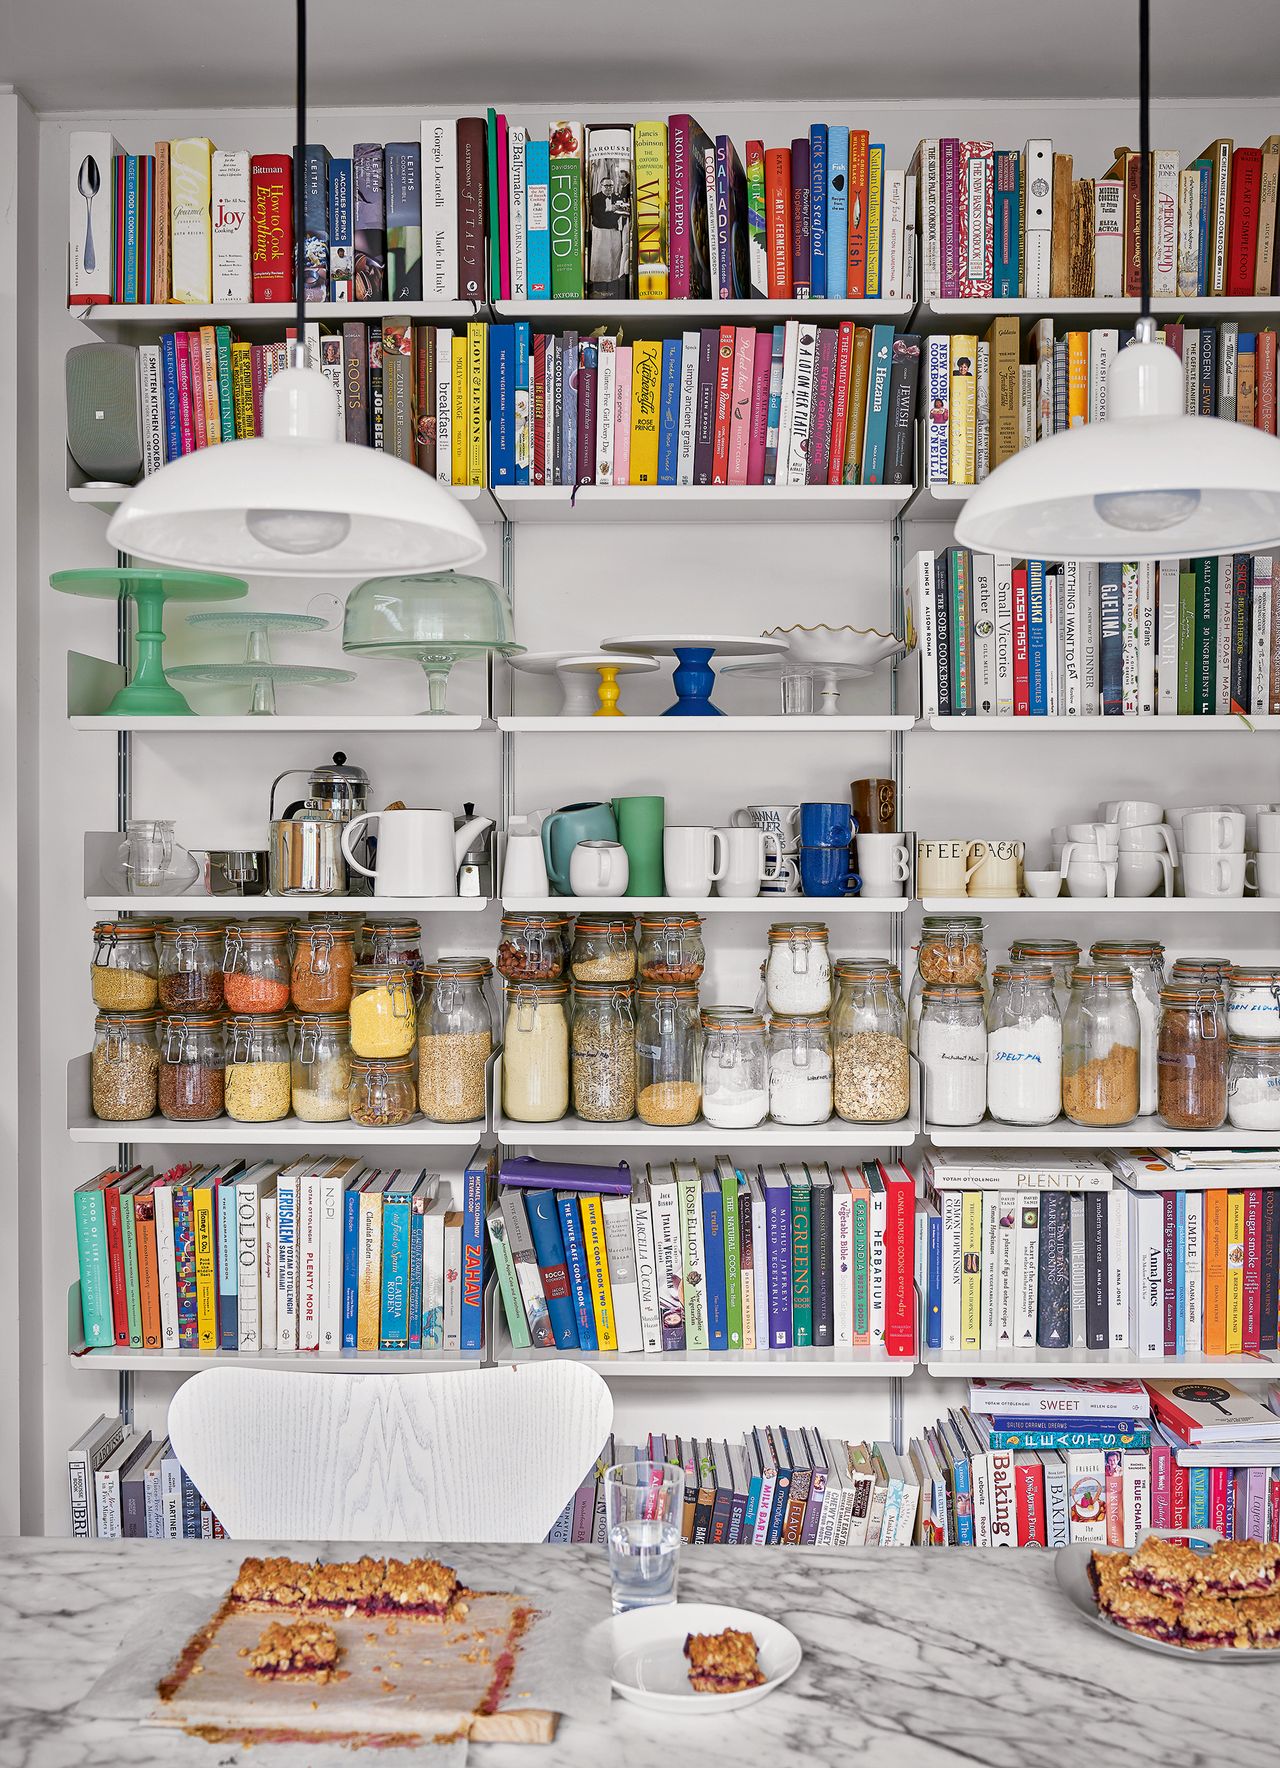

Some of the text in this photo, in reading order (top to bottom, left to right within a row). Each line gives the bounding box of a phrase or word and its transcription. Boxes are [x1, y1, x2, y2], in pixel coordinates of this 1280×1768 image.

[432, 127, 444, 207] Giorgio Locatelli
[513, 146, 523, 206] Ballymaloe
[675, 128, 683, 178] AROMAS
[129, 191, 137, 208] FOOD
[215, 204, 246, 230] Joy
[270, 184, 285, 260] How to Cook
[552, 175, 572, 257] FOOD
[637, 178, 660, 264] WINE
[675, 187, 683, 235] ALEPPO
[718, 148, 728, 244] SALADS
[811, 136, 825, 256] rick stein's seafood
[867, 151, 880, 293] Nathan Outlaw's British Seafood
[927, 148, 937, 241] THE SILVER PALATE COOKBOOK
[973, 162, 982, 259] THE NEW BASICS COOKBOOK
[128, 216, 136, 245] COOKING
[254, 185, 271, 262] Everything
[776, 199, 786, 286] ART FERMENTATION
[433, 231, 445, 295] Made In Italy
[1158, 246, 1174, 274] FOOD
[180, 359, 188, 390] barefoot
[348, 359, 361, 409] ROOTS
[473, 340, 481, 373] LOVE
[635, 348, 659, 415] Kitchenella
[840, 354, 848, 384] FAMILY
[930, 343, 939, 401] COOKBOOK
[939, 343, 948, 401] NEW YORK
[149, 358, 159, 430] SMITTEN KITCHEN
[439, 382, 450, 438] breakfast
[473, 387, 481, 443] LEMONS
[682, 363, 695, 458] simply ancient grains
[717, 367, 729, 419] IVAN Ramen
[793, 348, 812, 438] A LOT ON HER PLATE
[837, 385, 846, 418] DINNER
[873, 367, 887, 413] Hazana
[1262, 371, 1273, 420] PASSOVER
[938, 425, 948, 476] by MOLLY
[977, 576, 991, 613] gather
[1030, 562, 1043, 623] MAMUSHKA
[1101, 584, 1120, 639] GJELINA
[1203, 586, 1211, 619] CLARKE
[998, 582, 1011, 678] Small Victories
[1016, 588, 1027, 660] MISO TASTY
[1066, 618, 1074, 646] WANT
[1143, 607, 1153, 646] 26 Grains
[936, 612, 949, 704] SOBO COOKBOOK
[1066, 649, 1074, 662] TO
[1066, 663, 1078, 681] EAT
[1202, 627, 1210, 697] 30 INGREDIENTS
[325, 1187, 334, 1220] NOPI
[1017, 1174, 1084, 1188] PLENTY
[199, 1211, 208, 1232] Honey
[238, 1190, 257, 1266] POLPO
[278, 1188, 294, 1243] JERUSALEM
[685, 1186, 700, 1266] ROSE ELLIOT'S
[838, 1201, 849, 1260] Vegetable Bible
[1165, 1222, 1175, 1236] figs
[1188, 1214, 1197, 1257] SIMPLE
[1246, 1192, 1258, 1267] salt sugar smoke
[201, 1242, 209, 1251] Co.
[636, 1208, 653, 1303] MARCELLA CUCINA
[794, 1214, 809, 1294] GREENS
[873, 1230, 882, 1309] HERBARIUM
[897, 1246, 905, 1273] COOKS
[1165, 1239, 1173, 1259] sugar
[464, 1245, 480, 1306] ZAHAV
[1147, 1247, 1162, 1306] Anna Jones
[306, 1294, 314, 1320] MORE
[1040, 1400, 1080, 1411] SWEET
[1025, 1433, 1116, 1447] FEASTS
[773, 1491, 785, 1528] momofuku
[992, 1453, 1013, 1537] Baking
[1134, 1480, 1142, 1531] BLUE CHAIR
[1253, 1495, 1264, 1539] Layered
